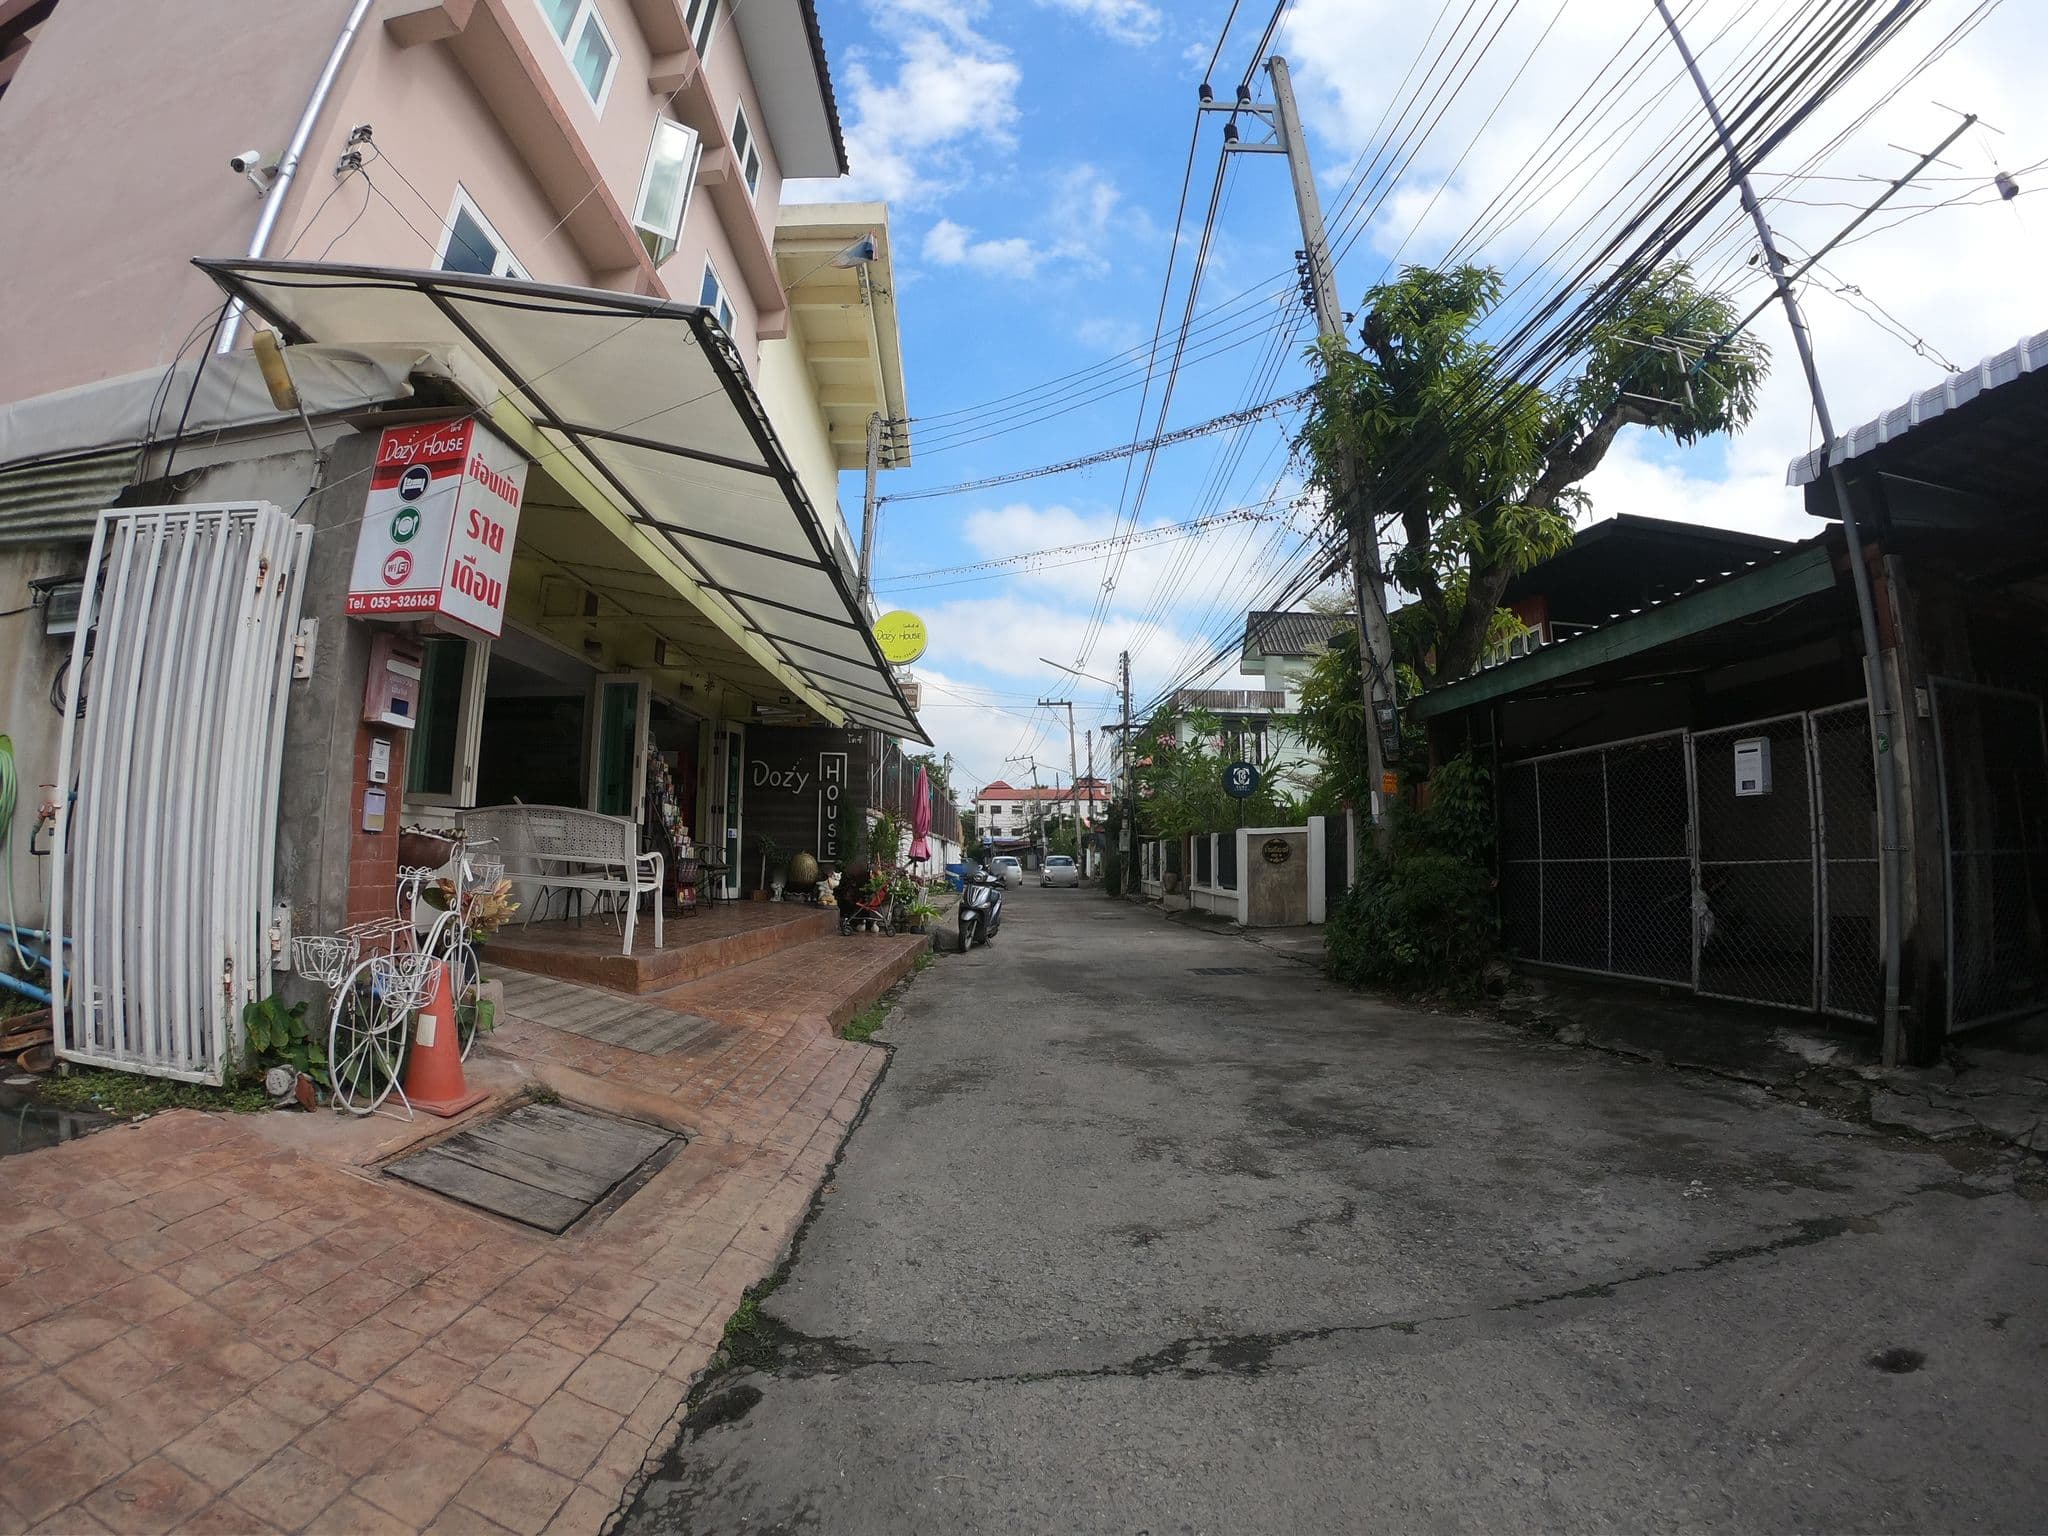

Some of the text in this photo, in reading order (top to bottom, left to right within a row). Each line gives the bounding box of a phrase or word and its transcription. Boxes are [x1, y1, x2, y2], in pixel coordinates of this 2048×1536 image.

[385, 433, 464, 465] Dozy HOUSE
[469, 453, 519, 507] ห้องพัก
[466, 509, 505, 554] ราย
[349, 594, 436, 609] Tel. 053-326168
[451, 554, 502, 609] เดือน
[752, 760, 809, 794] Dozy
[826, 758, 839, 857] HOUSE
